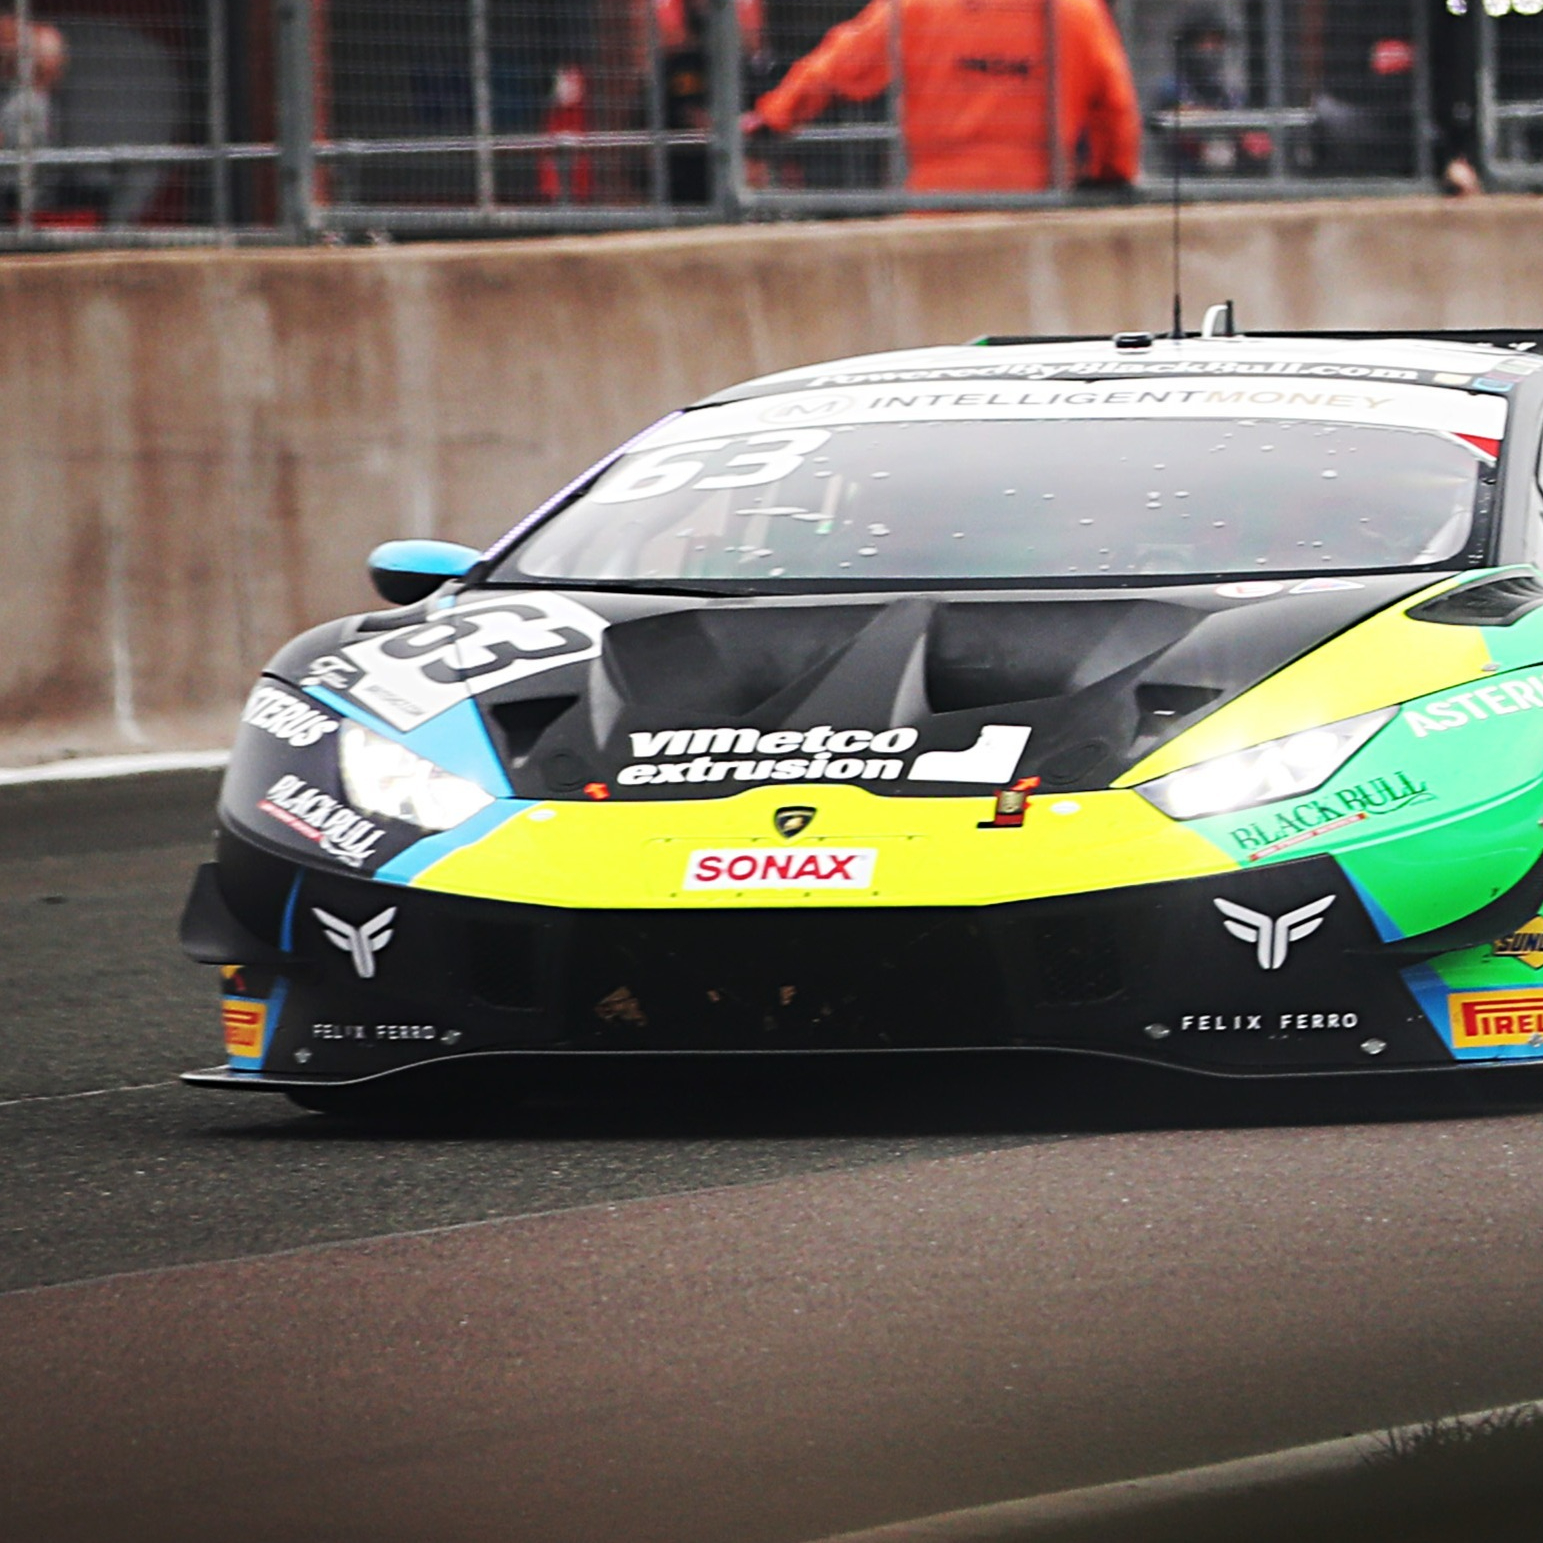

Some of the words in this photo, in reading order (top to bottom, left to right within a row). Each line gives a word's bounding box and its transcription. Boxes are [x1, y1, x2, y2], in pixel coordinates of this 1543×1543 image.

[867, 390, 1395, 410] INTELLIGENTMONEY
[590, 427, 833, 504] 63
[380, 602, 595, 684] 63
[628, 724, 919, 757] vimetco
[616, 751, 905, 786] extrusion
[1229, 797, 1344, 851] BLACK
[1335, 770, 1429, 817] BULL
[693, 854, 858, 882] SONAX
[313, 1023, 367, 1039] FELIX
[375, 1024, 436, 1040] FERRO
[1181, 1014, 1262, 1031] FELIX
[1280, 1012, 1359, 1030] FERRO
